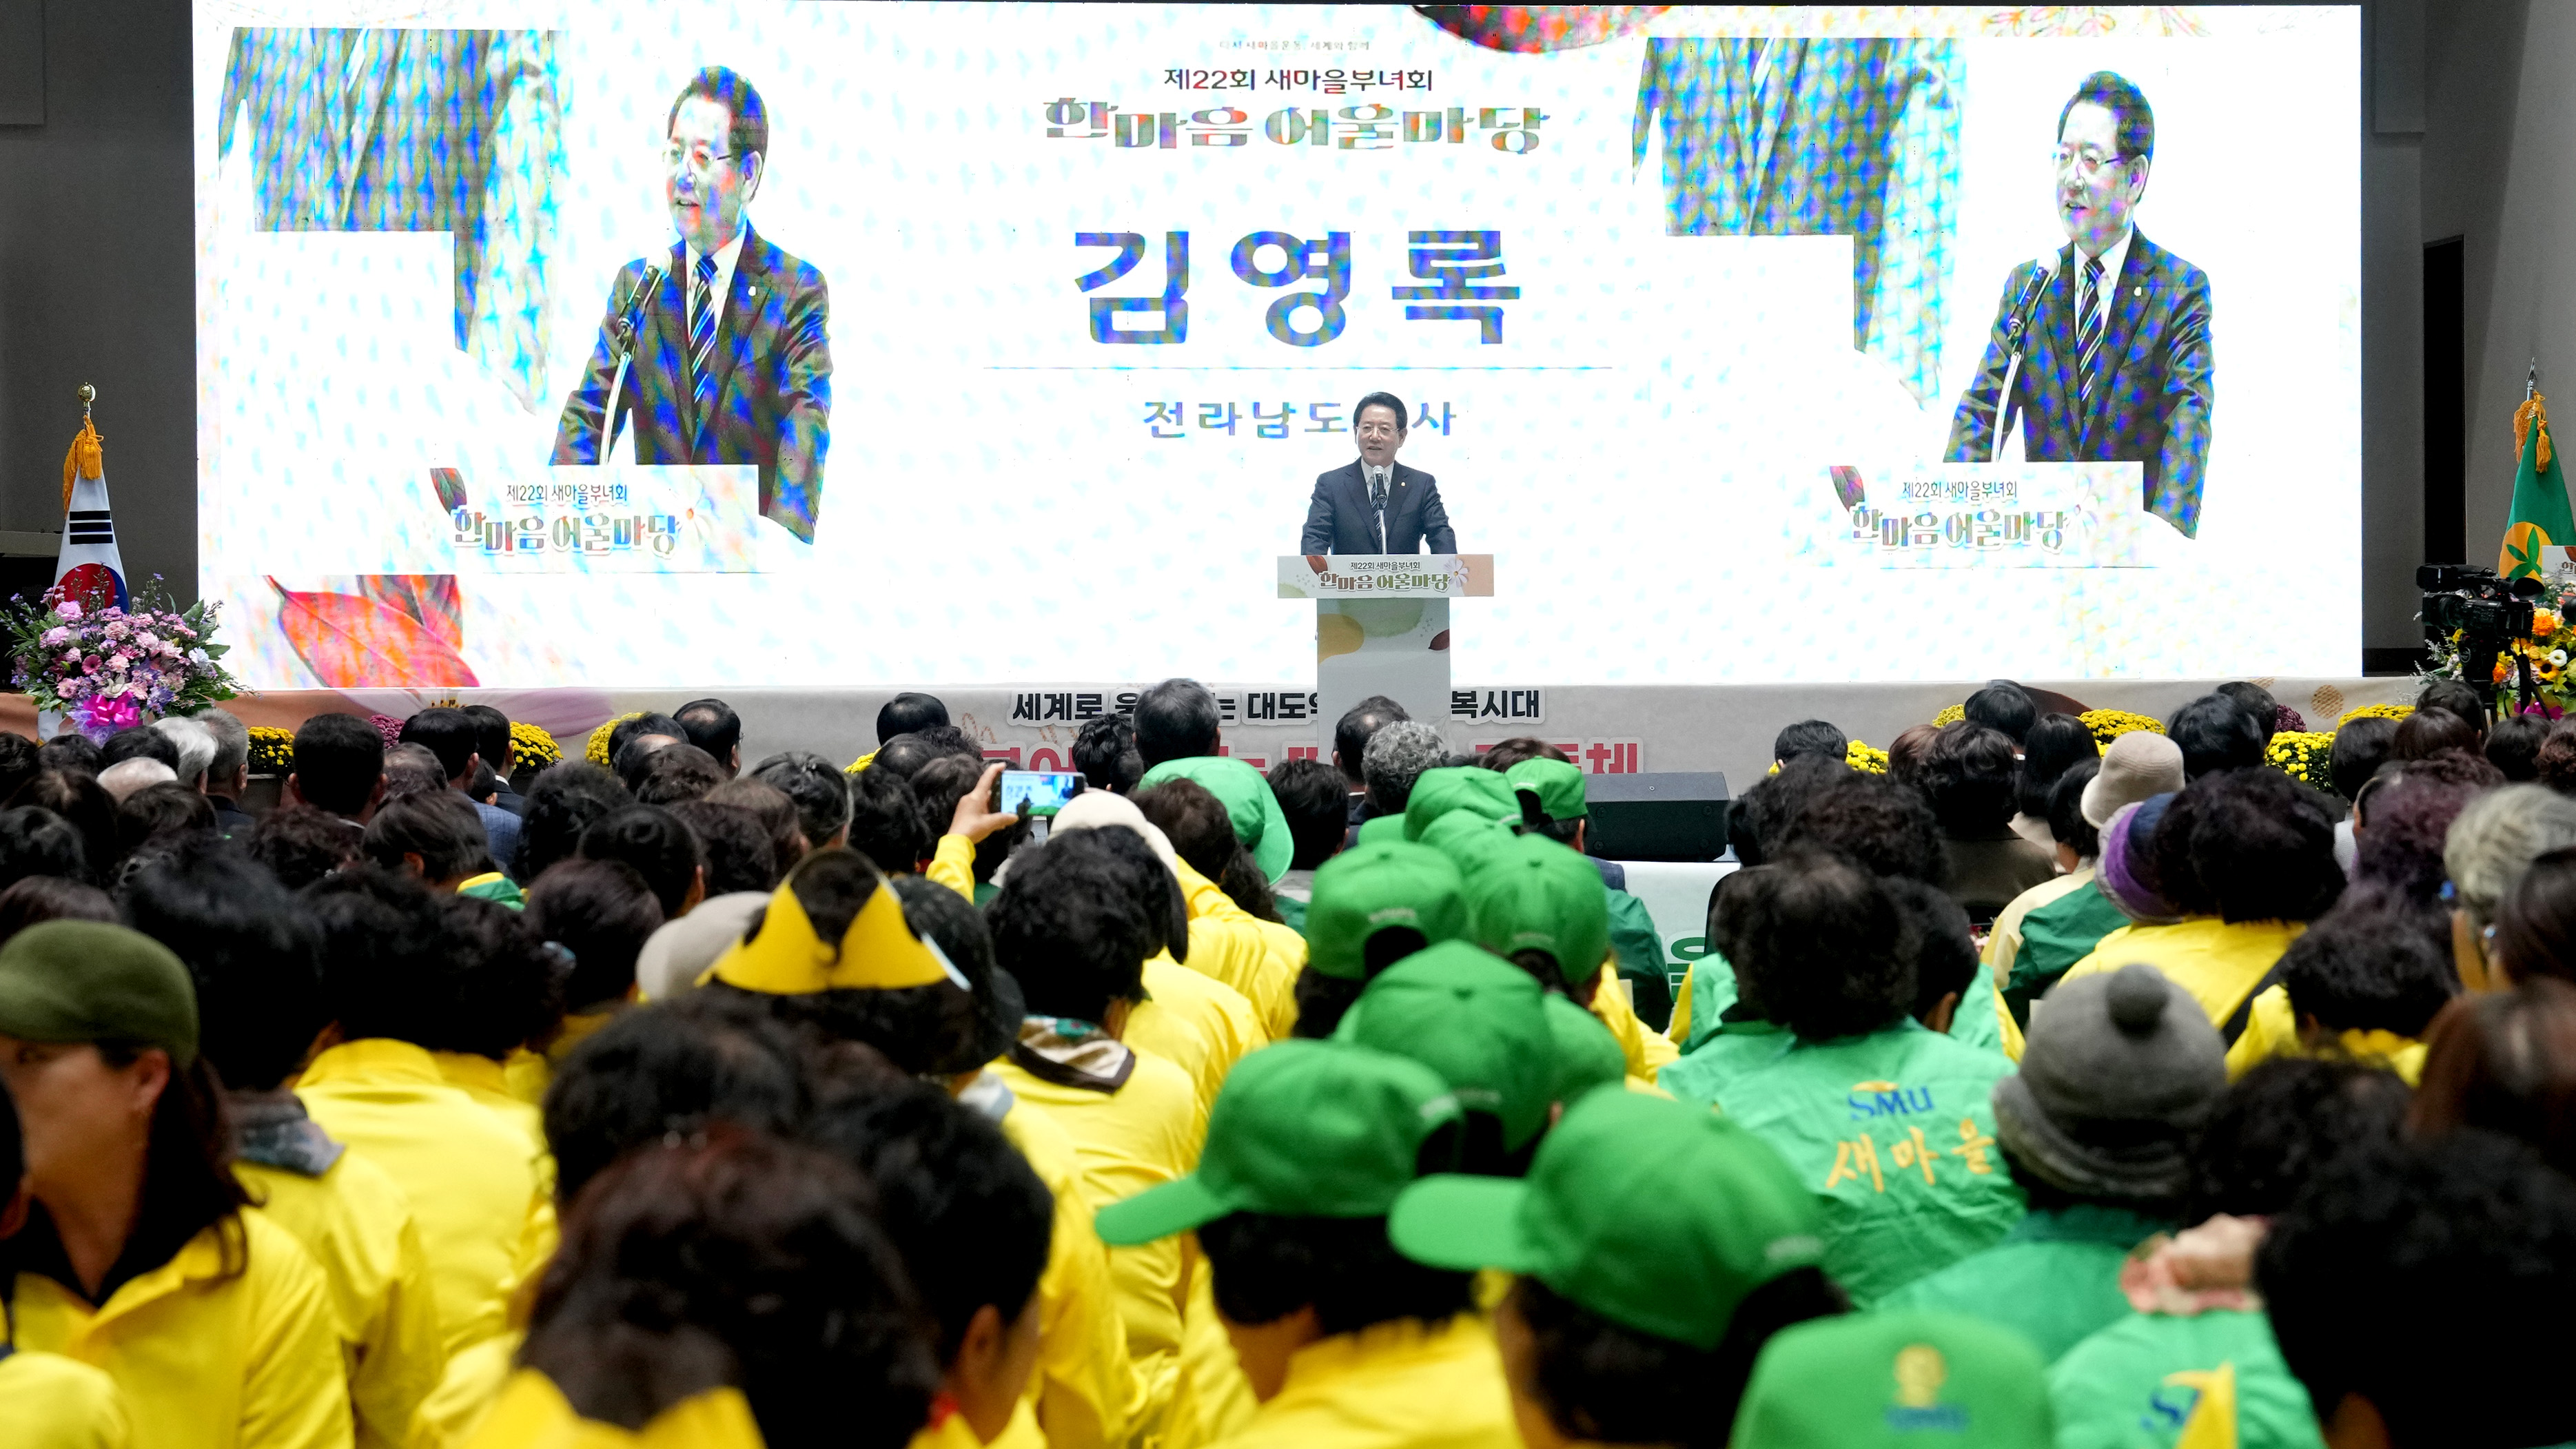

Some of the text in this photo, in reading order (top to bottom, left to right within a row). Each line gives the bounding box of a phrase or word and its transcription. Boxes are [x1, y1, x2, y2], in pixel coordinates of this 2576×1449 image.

[1164, 68, 1433, 94] 제22회 새마을부녀회
[1043, 97, 1551, 154] 한마음 어울마당
[1075, 231, 1520, 347] 김영록
[1143, 401, 1457, 439] 전라남도사
[507, 484, 628, 504] 제22회 새마을부녀회
[1902, 480, 2018, 501] 제22회 새마을부녀회
[454, 509, 680, 555] 한마음 어울마당
[1852, 506, 2067, 551] 한마음 어울마당
[1320, 572, 1451, 591] 한마음 어울마당
[1350, 562, 1421, 571] 제22회 새마을부녀회
[1012, 692, 1103, 721] 세계로
[1451, 690, 1540, 719] 복시대
[1848, 1086, 1935, 1120] SMU
[1825, 1118, 1996, 1193] 새마을
